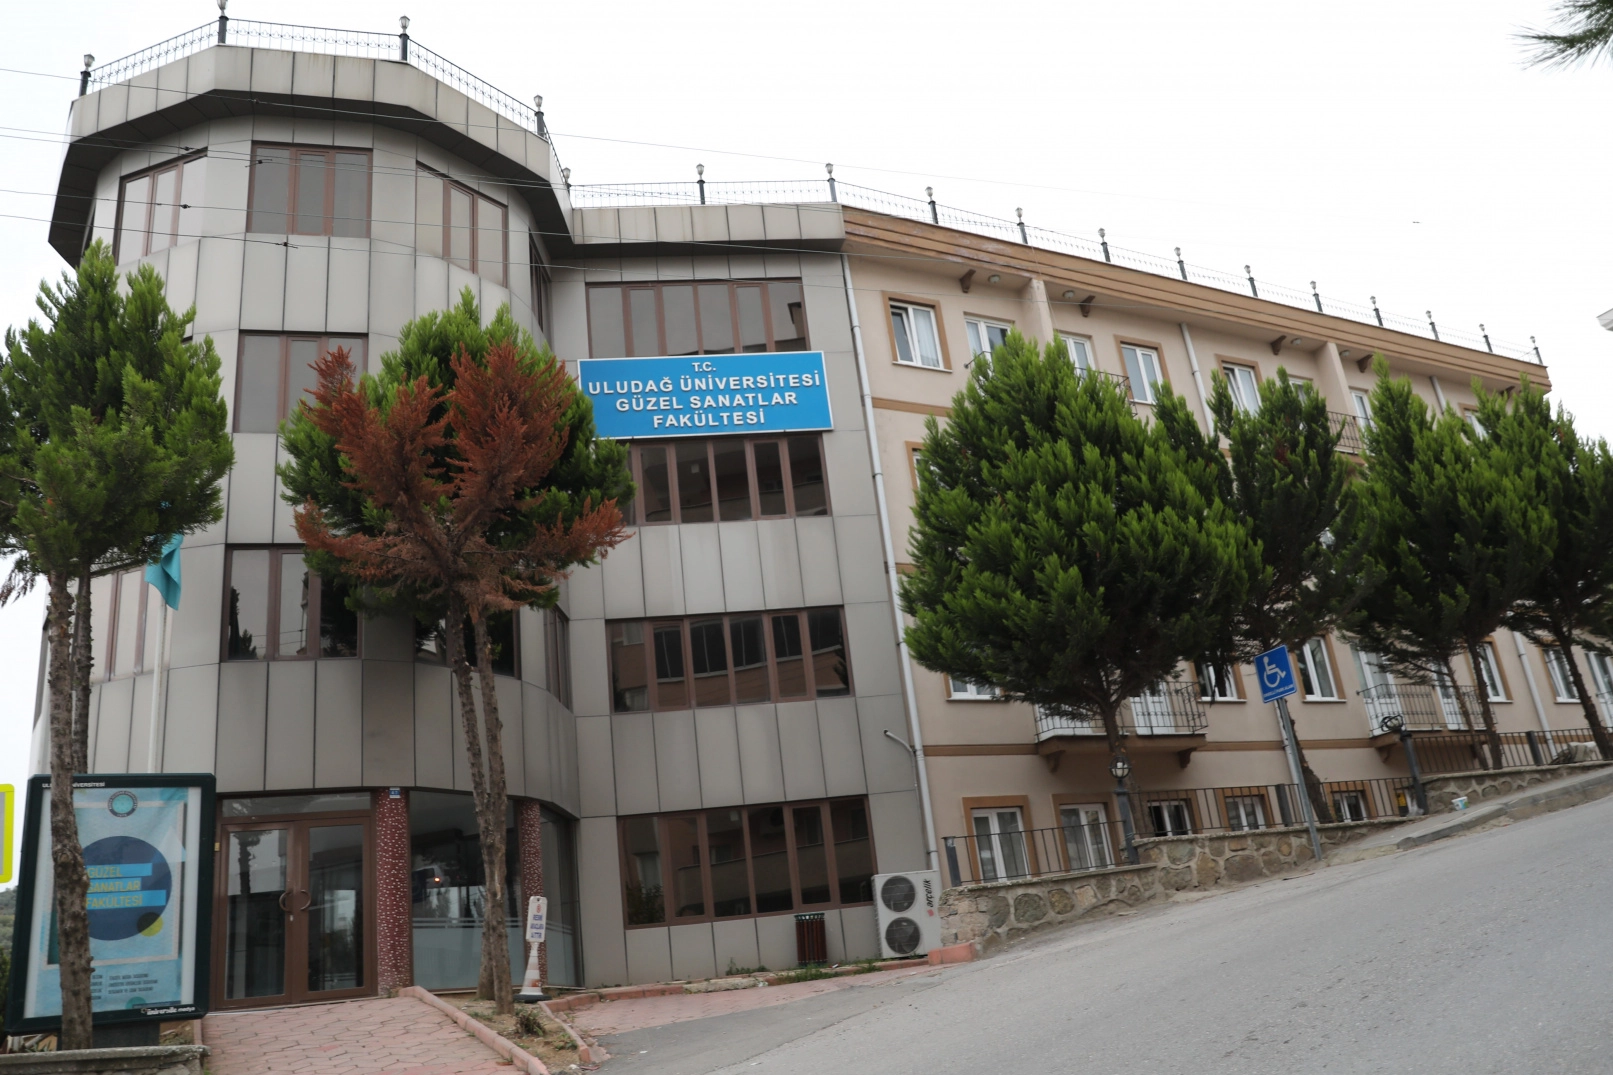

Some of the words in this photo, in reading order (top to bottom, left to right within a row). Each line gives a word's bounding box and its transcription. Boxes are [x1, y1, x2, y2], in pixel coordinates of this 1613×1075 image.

[691, 362, 717, 373] T.C.
[588, 376, 674, 395] ULUDAĞ
[680, 370, 821, 392] ÜNİVERSİTESİ
[616, 396, 684, 412] GÜZEL
[690, 392, 798, 409] SANATLAR
[653, 409, 766, 429] FAKÜLTESİ
[87, 866, 123, 878] GÜZEL
[87, 880, 141, 893] SANATLAR
[86, 893, 143, 909] FAKÜLTESİ
